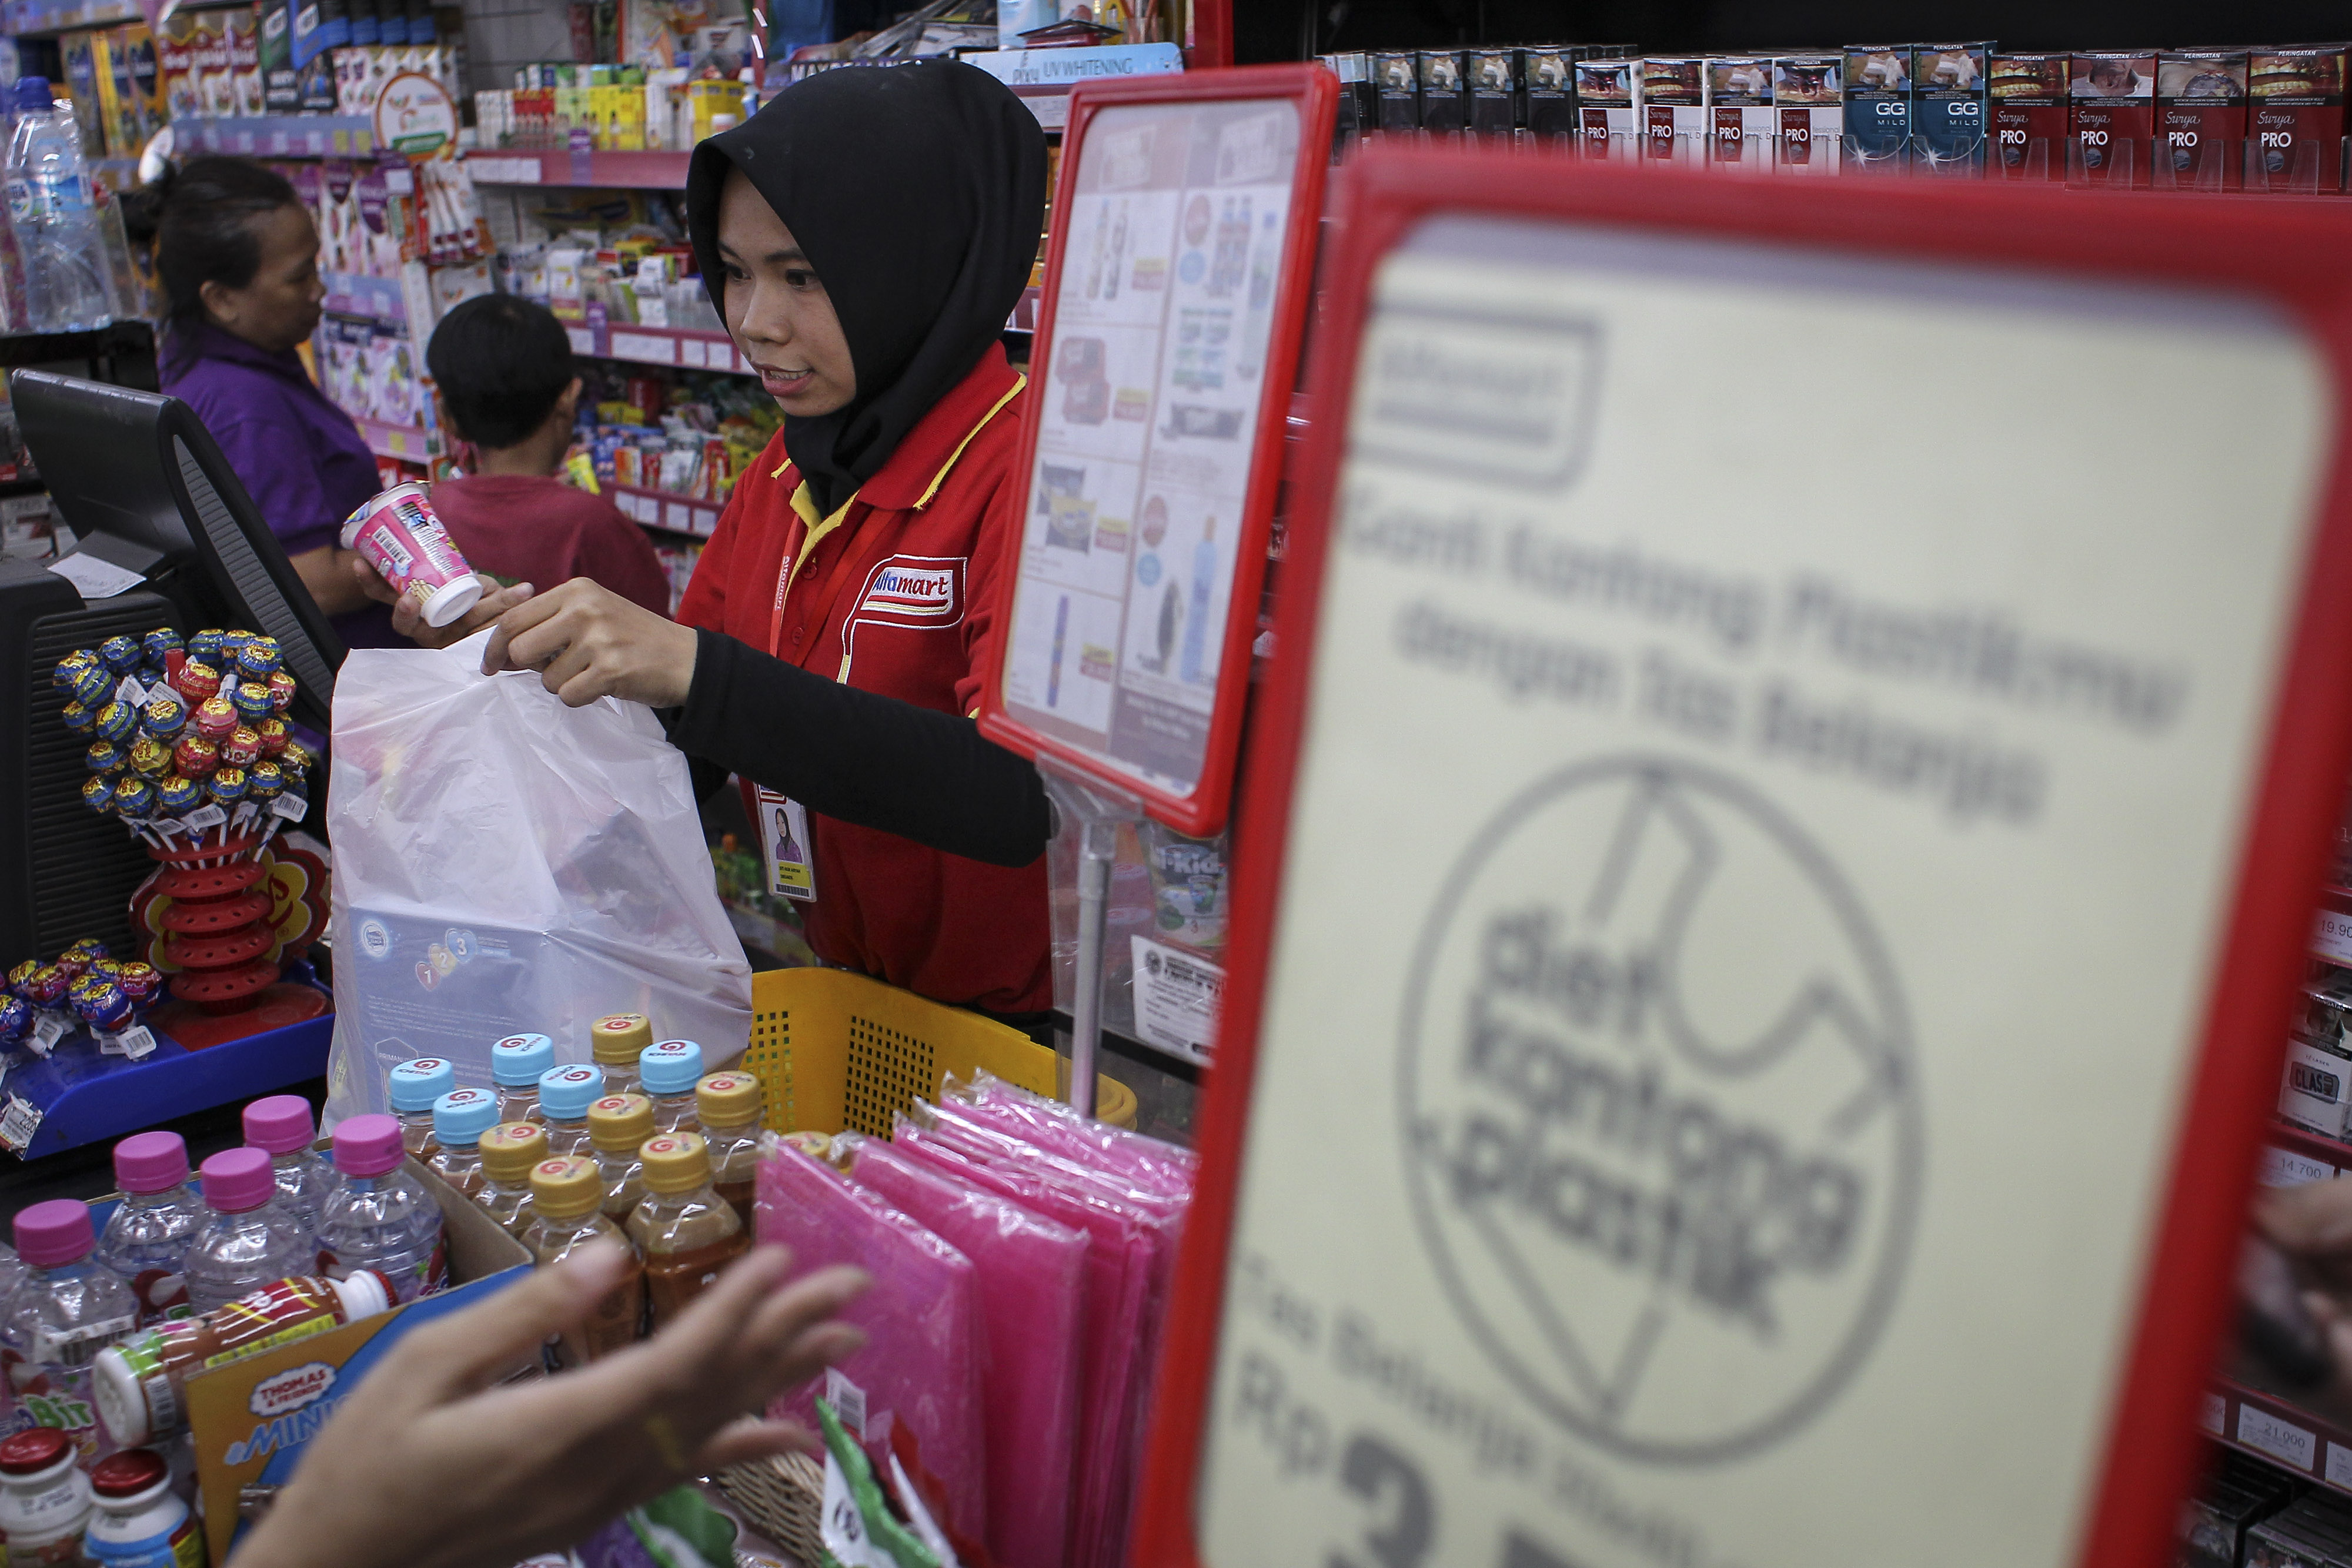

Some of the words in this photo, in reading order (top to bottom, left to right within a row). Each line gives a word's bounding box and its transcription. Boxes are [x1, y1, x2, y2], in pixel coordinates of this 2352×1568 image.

[1059, 58, 1134, 76] WHITENING
[1876, 102, 1906, 116] GG
[1947, 102, 1979, 116] GG
[1997, 111, 2029, 127] Surya
[2077, 111, 2111, 128] Surya
[2165, 111, 2201, 129] Surya
[2257, 111, 2296, 129] Surya
[1588, 127, 1608, 140] PRO
[1651, 125, 1672, 138] PRO
[1719, 126, 1741, 141] PRO
[1785, 128, 1809, 142] PRO
[2000, 130, 2027, 145] PRO
[2080, 131, 2109, 146] PRO
[2168, 131, 2198, 147] PRO
[2261, 132, 2292, 148] PRO
[455, 937, 469, 956] 3
[439, 952, 449, 969] 2
[424, 969, 432, 984] 1
[1479, 901, 1667, 1038] diet
[2295, 1068, 2324, 1095] CLAS
[1461, 985, 1865, 1281] kantong
[260, 1368, 327, 1399] THOMAS
[268, 1399, 275, 1407] &
[277, 1382, 323, 1403] FRIENDS
